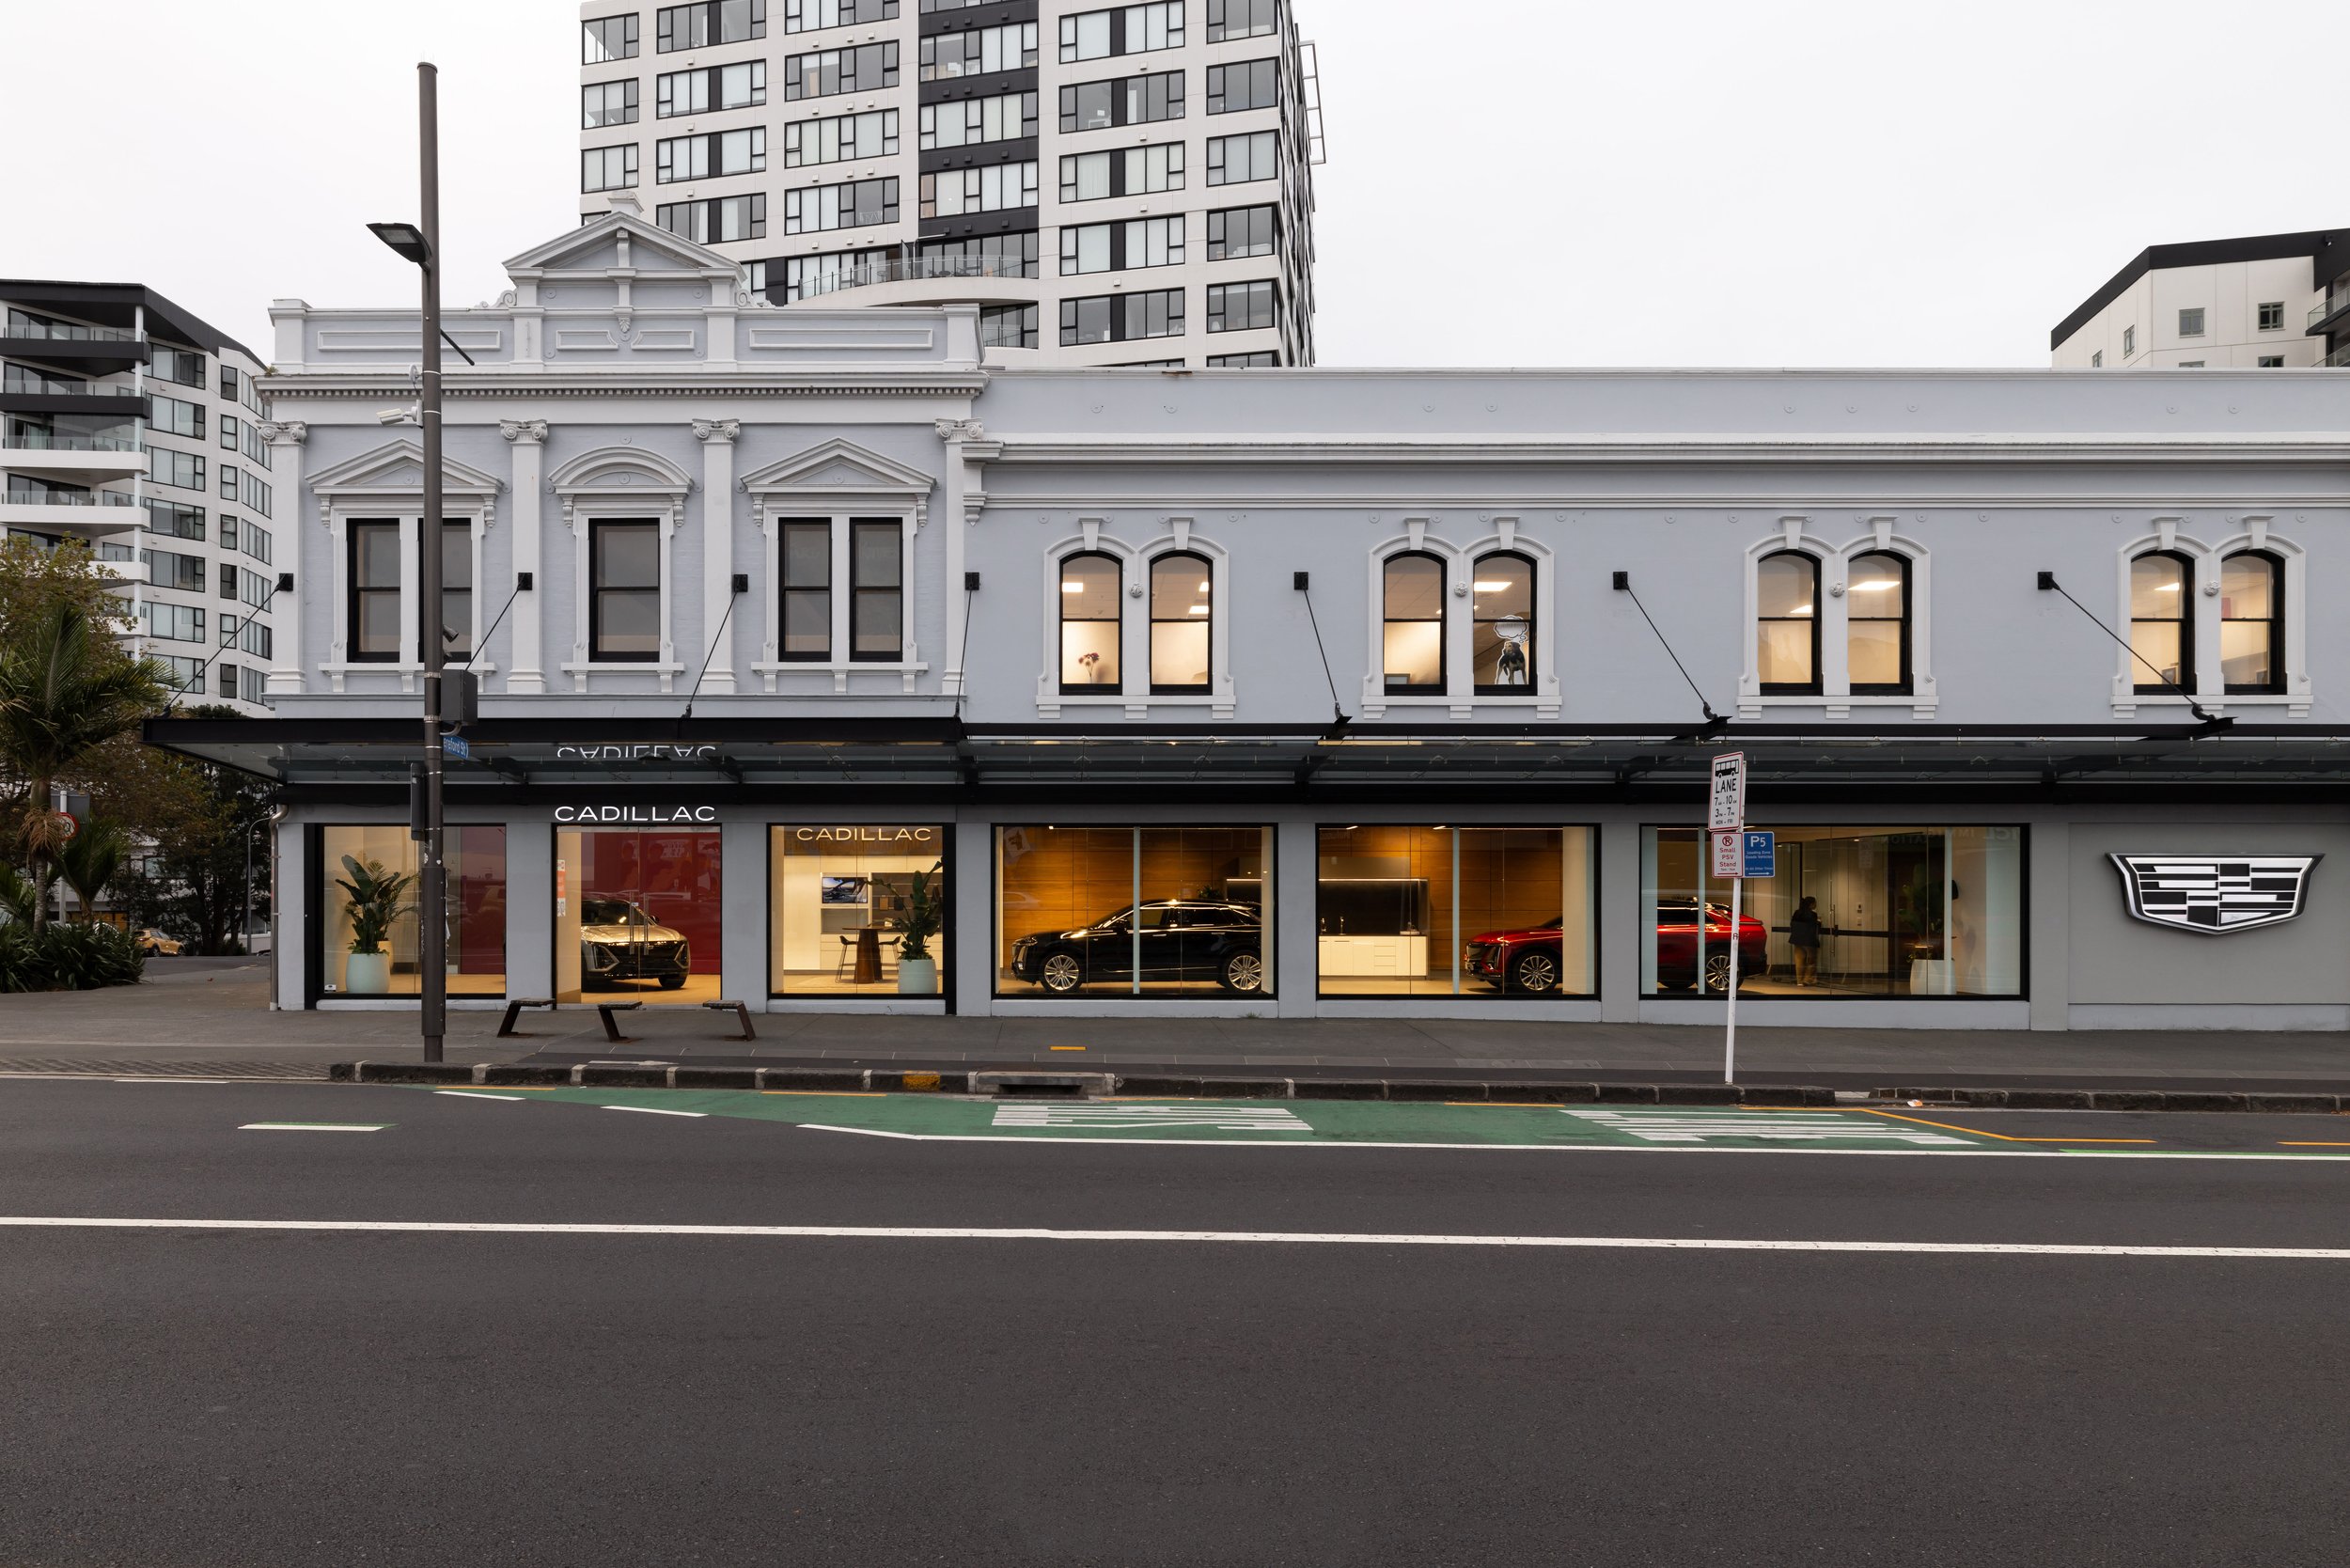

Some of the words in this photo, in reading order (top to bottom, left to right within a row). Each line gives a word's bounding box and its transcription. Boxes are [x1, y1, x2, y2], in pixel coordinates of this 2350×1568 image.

[1716, 778, 1737, 793] LANE
[555, 806, 715, 822] CADILLAC
[796, 827, 932, 841] CADILLAC
[1750, 836, 1766, 847] P5
